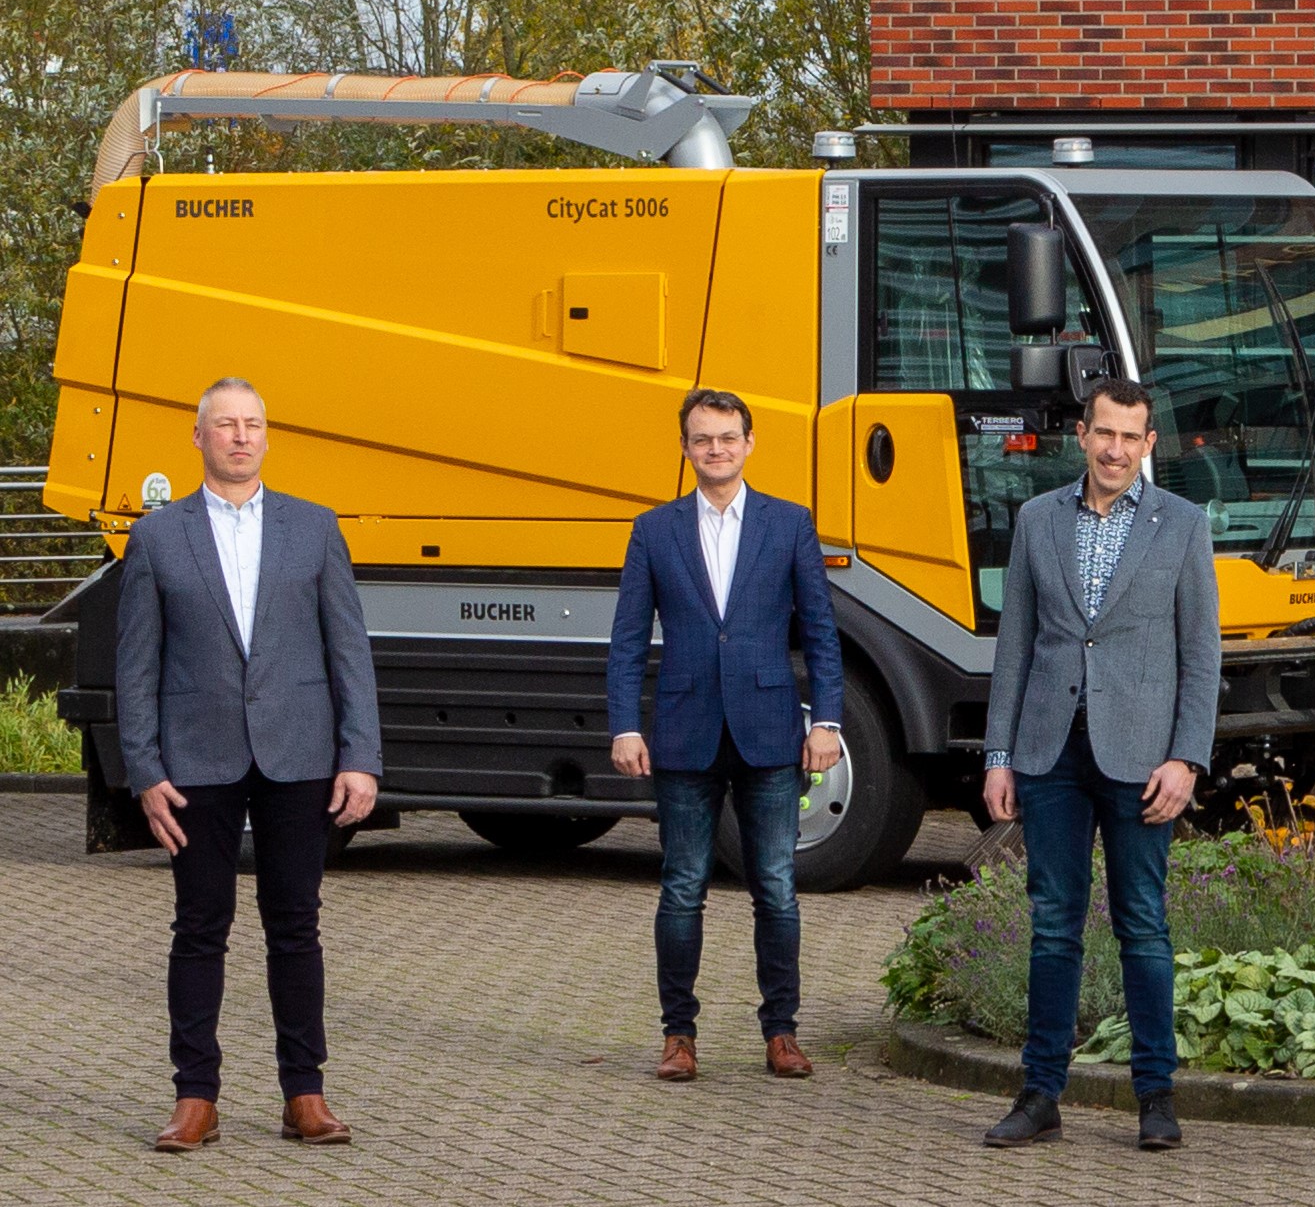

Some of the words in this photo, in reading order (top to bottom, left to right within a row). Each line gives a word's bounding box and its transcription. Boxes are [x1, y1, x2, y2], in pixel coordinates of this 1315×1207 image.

[175, 199, 254, 218] BUCHER
[546, 197, 618, 224] CityCat
[624, 198, 669, 217] 5006
[460, 602, 535, 621] BUCHER
